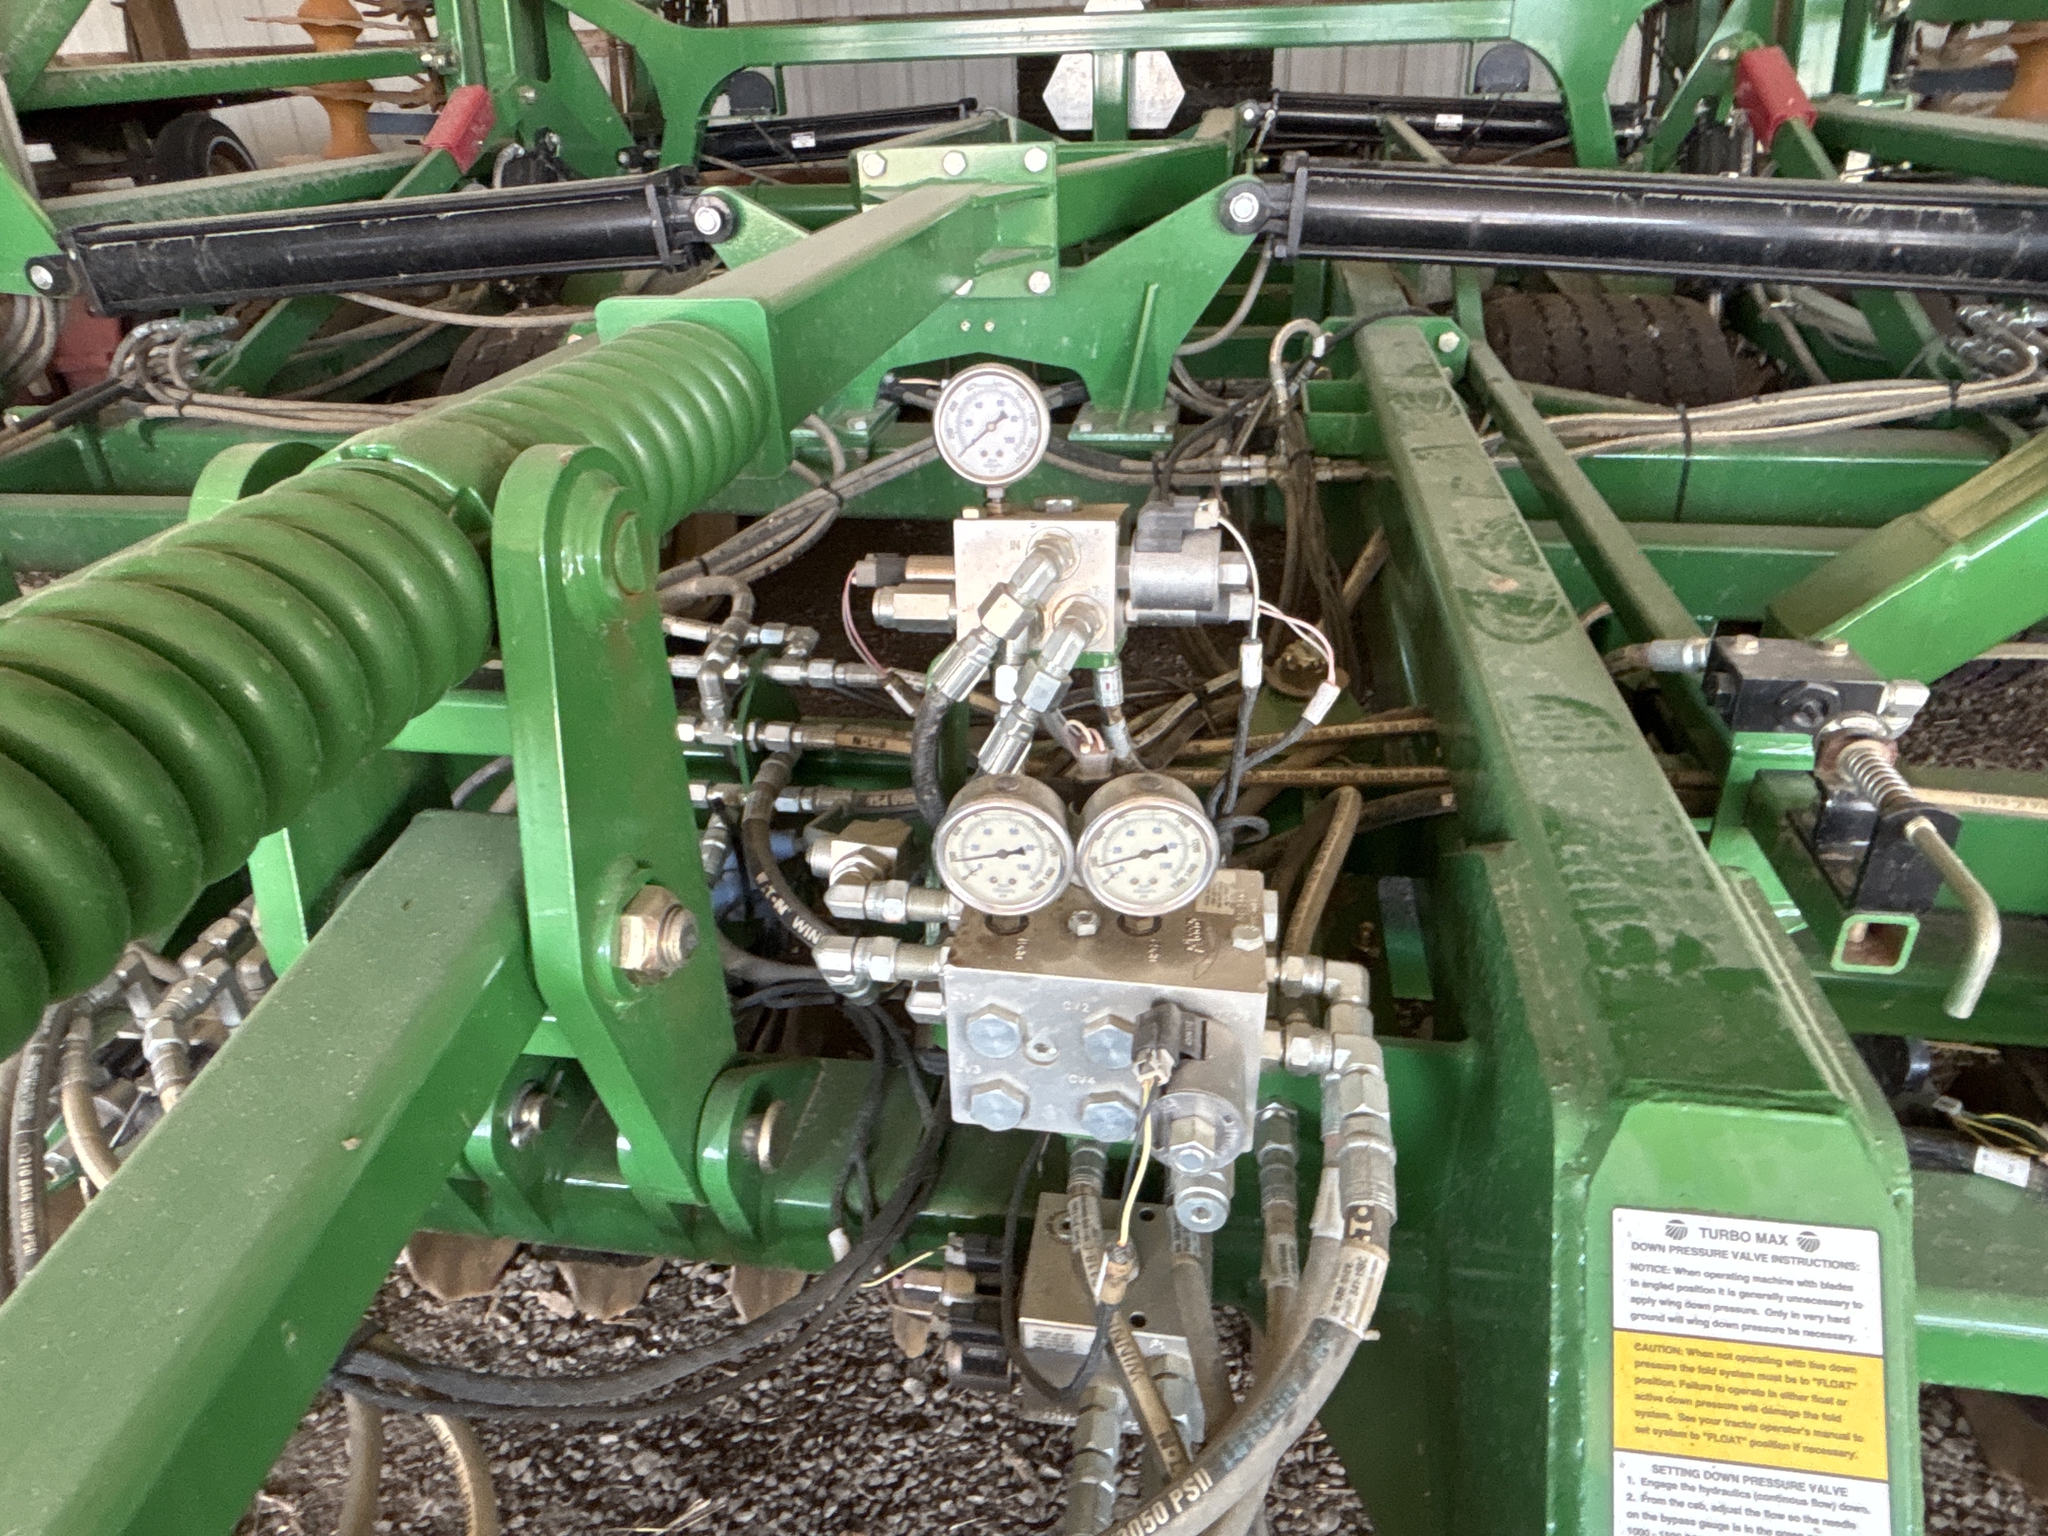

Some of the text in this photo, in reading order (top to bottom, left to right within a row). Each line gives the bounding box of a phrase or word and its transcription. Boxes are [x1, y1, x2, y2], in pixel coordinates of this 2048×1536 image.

[1068, 1074, 1097, 1085] CV4
[1698, 1227, 1788, 1246] TURBO MAX
[1631, 1241, 1861, 1271] DOWN PRESSURE VALVE INSTRUCTIONS:
[1630, 1262, 1854, 1292] NOTICE: When operating machine with blades
[1630, 1296, 1851, 1324] apply wing down pressure. Only in very hard
[1642, 1280, 1674, 1291] angled
[1676, 1284, 1716, 1294] position
[1718, 1287, 1725, 1296] it
[1727, 1288, 1736, 1297] is
[1739, 1291, 1783, 1303] generally
[1786, 1295, 1850, 1310] unnecessary
[1852, 1301, 1864, 1309] to
[1630, 1312, 1857, 1344] ground will wing down pressure be necessary.
[1634, 1342, 1683, 1355] CAUTION:
[1685, 1347, 1714, 1358] When
[1716, 1352, 1733, 1360] not
[1735, 1354, 1782, 1368] operating
[1785, 1359, 1806, 1368] with
[1828, 1363, 1857, 1374] down
[1634, 1360, 1857, 1390] pressure the fold system must be in "FLOAT"
[1634, 1377, 1677, 1387] position.
[1679, 1380, 1713, 1391] Failure
[1715, 1384, 1725, 1392] to
[1728, 1386, 1765, 1397] operate
[1767, 1389, 1777, 1397] in
[1779, 1391, 1809, 1402] either
[1811, 1394, 1834, 1405] float
[1634, 1393, 1842, 1423] active down pressure will damage the fold
[1635, 1410, 1864, 1442] system. See your tractor operator's manual to
[1635, 1426, 1859, 1461] set system to "FLOAT" position if necessary.
[1627, 1475, 1636, 1485] 1.
[1641, 1477, 1678, 1491] Engage
[1680, 1483, 1696, 1492] the
[1698, 1484, 1751, 1499] hydraulics
[1811, 1498, 1837, 1512] flow)
[1651, 1464, 1848, 1497] SETTING DOWN PRESSURE VALVE
[1626, 1492, 1857, 1529] 2. From the cab, adjust the flow so the needle
[1626, 1511, 1639, 1519] on
[1642, 1512, 1658, 1521] the
[1660, 1513, 1697, 1526] bypass
[1698, 1520, 1730, 1532] gauge
[1732, 1522, 1742, 1532] is
[1744, 1524, 1754, 1534] in
[1756, 1526, 1773, 1536] the
